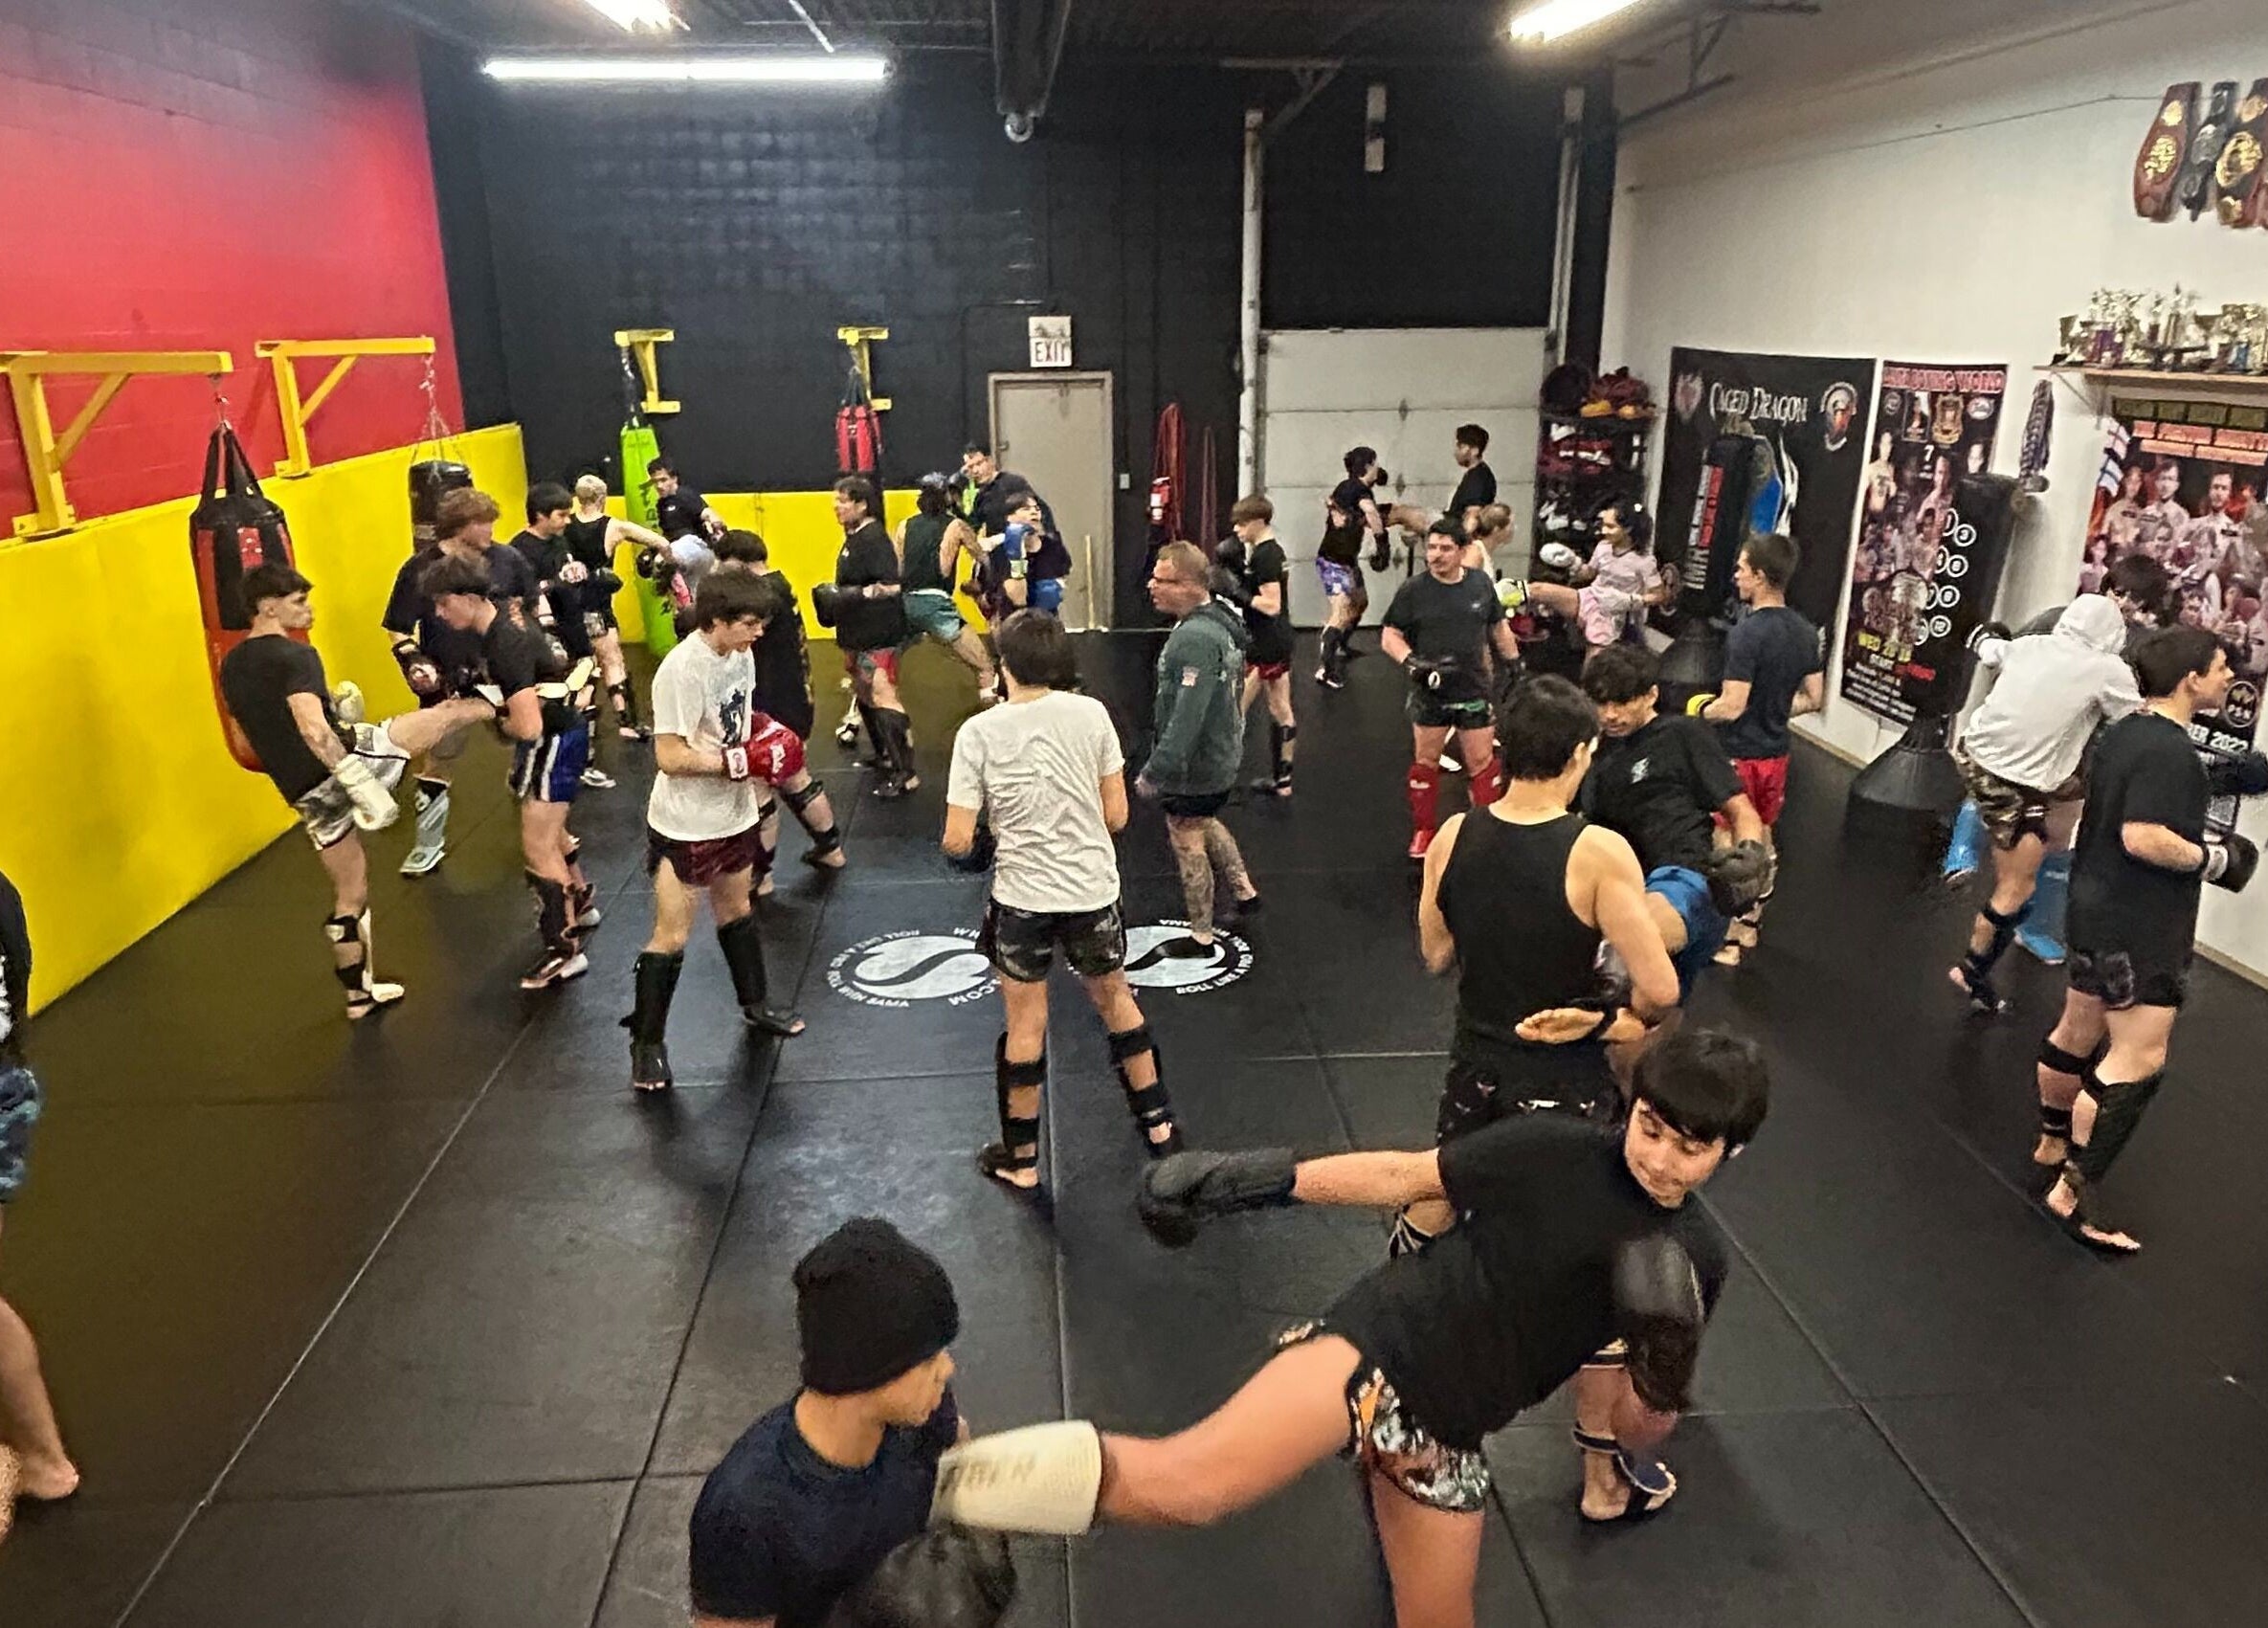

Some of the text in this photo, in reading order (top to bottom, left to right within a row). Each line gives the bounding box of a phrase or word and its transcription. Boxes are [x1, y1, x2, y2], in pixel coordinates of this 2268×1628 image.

[1035, 340, 1069, 363] EXIT
[1748, 387, 1809, 427] DRAGON
[884, 929, 920, 940] ROLL
[1175, 983, 1213, 994] ROLL
